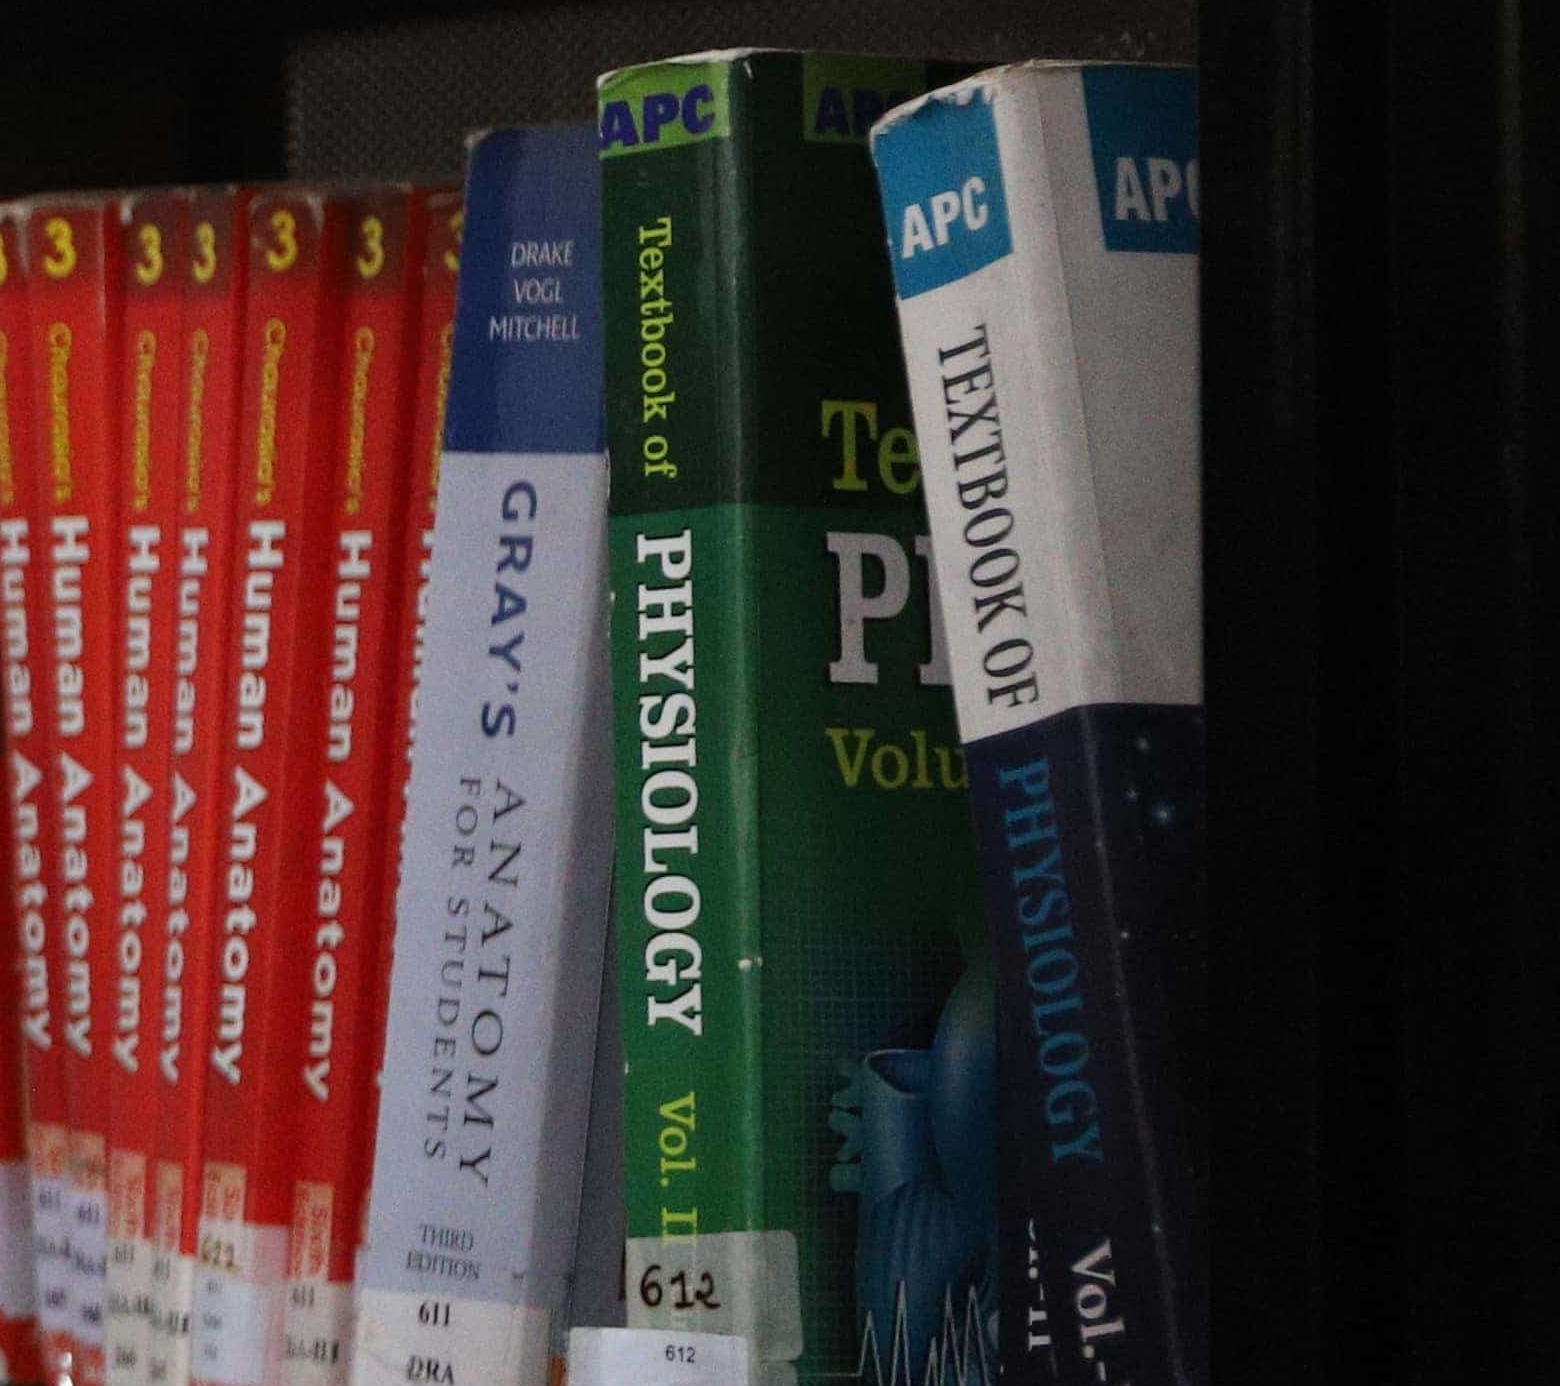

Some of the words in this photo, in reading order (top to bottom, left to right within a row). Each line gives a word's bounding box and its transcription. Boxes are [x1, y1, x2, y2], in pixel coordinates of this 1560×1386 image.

[599, 83, 716, 152] APC
[44, 217, 77, 277] 3
[136, 223, 163, 286] 3
[193, 221, 217, 284] 3
[265, 209, 298, 273] 3
[358, 217, 385, 280] 3
[511, 240, 575, 268] DRAKE
[901, 176, 988, 260] APC
[489, 315, 581, 341] MITCHELL
[513, 278, 564, 303] VOGL
[638, 217, 677, 424] Textbook
[643, 435, 678, 479] of
[938, 323, 1028, 633] TEXTBOOK
[0, 518, 34, 738] Human
[51, 515, 90, 738] Human
[124, 524, 161, 749] Human
[174, 527, 209, 755] Human
[236, 520, 286, 750] Human
[327, 530, 373, 762] Human
[481, 480, 538, 738] GRAY'S
[982, 639, 1040, 709] OF
[450, 776, 482, 870] FOR
[636, 530, 704, 1037] PHYSIOLOGY
[12, 750, 51, 1051] Anatomy
[59, 750, 94, 1057] Anatomy
[112, 763, 154, 1074] Anatomy
[159, 770, 197, 1085] Anatomy
[212, 765, 269, 1085] Anatomy
[304, 780, 355, 1102] Anatomy
[458, 777, 526, 1189] ANATOMY
[999, 759, 1104, 1168] PHYSIOLOGY
[424, 896, 469, 1161] STUDENTS
[658, 1090, 697, 1187] Vol.
[406, 1250, 480, 1280] EDITION
[420, 1224, 474, 1253] THIRD
[640, 1264, 720, 1310] 612
[419, 1301, 451, 1326] 611
[664, 1346, 696, 1364] 612
[407, 1355, 455, 1386] DRA
